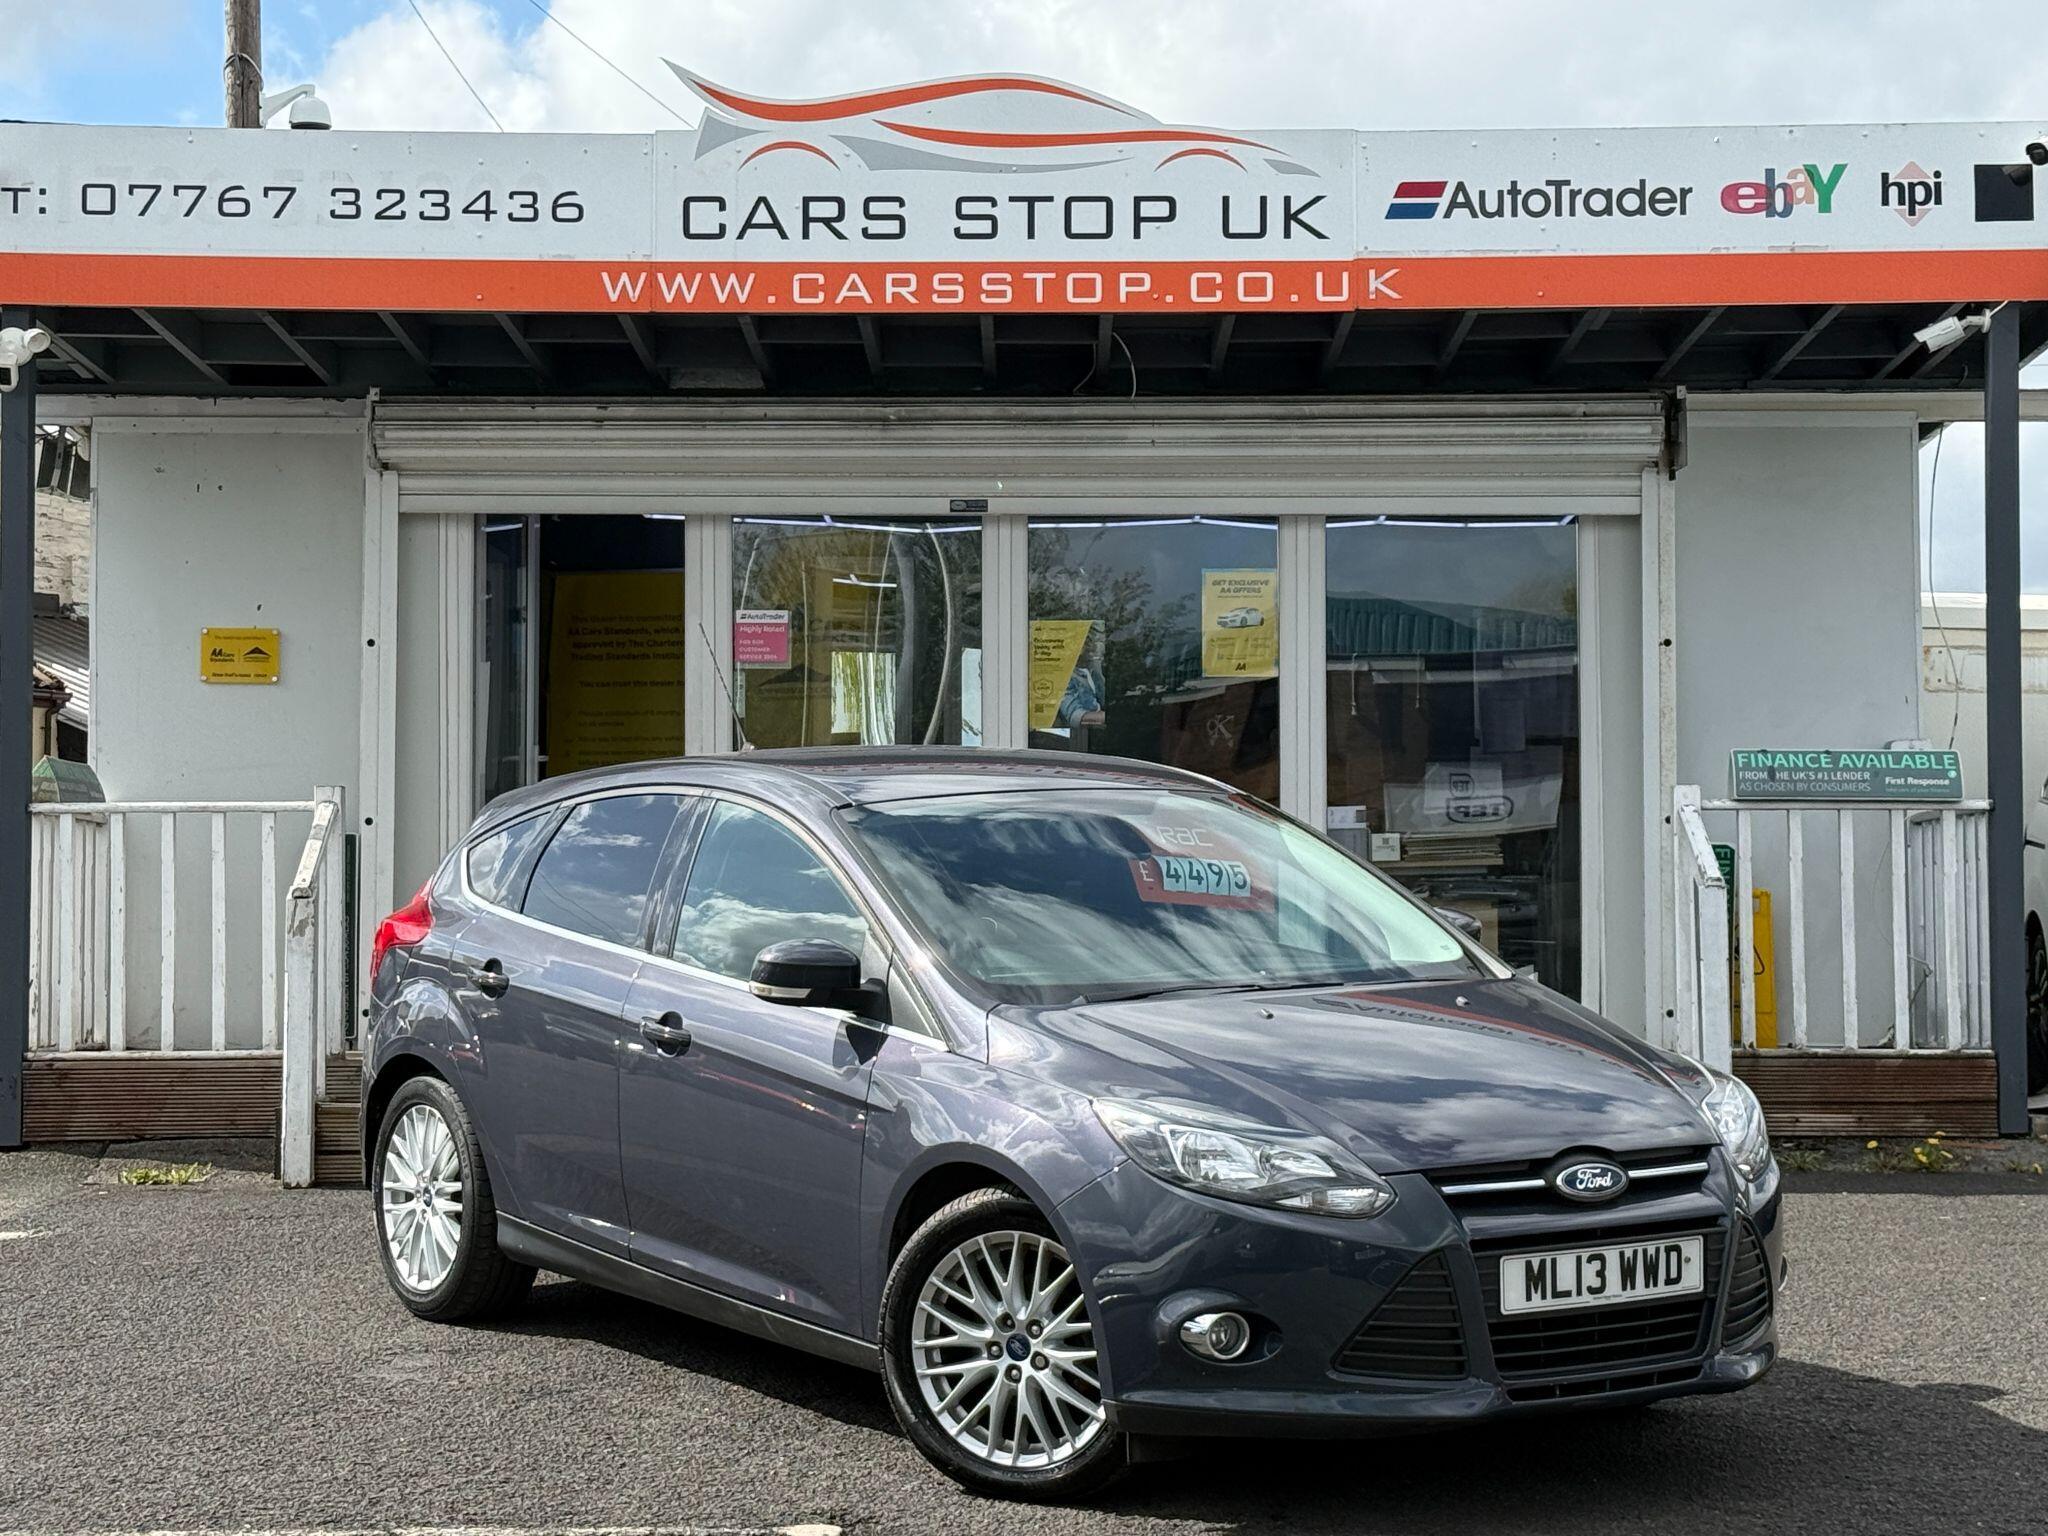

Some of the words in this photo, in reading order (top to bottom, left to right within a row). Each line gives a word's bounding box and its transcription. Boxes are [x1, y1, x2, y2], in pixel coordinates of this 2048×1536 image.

[81, 184, 297, 219] 07767
[329, 187, 584, 223] 323436
[1443, 179, 1693, 219] AutoTrader
[1881, 170, 1943, 217] hpi
[682, 195, 906, 241] CARS
[953, 195, 1177, 240] STOP
[1222, 195, 1330, 240] UK
[1737, 752, 1834, 769] FINANCE
[1838, 753, 1957, 770] AVAILABLE
[1739, 770, 1767, 780] FROM
[1769, 770, 1790, 780] HE
[1792, 771, 1816, 780] UK'S
[1830, 771, 1871, 781] LENDER
[1739, 781, 1752, 791] AS
[1753, 781, 1795, 791] CHOSEN
[1796, 782, 1809, 791] BY
[1810, 781, 1872, 792] CONSUMERS
[1885, 776, 1906, 785] First
[1907, 776, 1950, 787] Response
[1164, 859, 1249, 890] 4495
[1575, 1167, 1614, 1190] Ford
[1524, 1252, 1608, 1303] ML13
[1618, 1243, 1683, 1293] WWD
